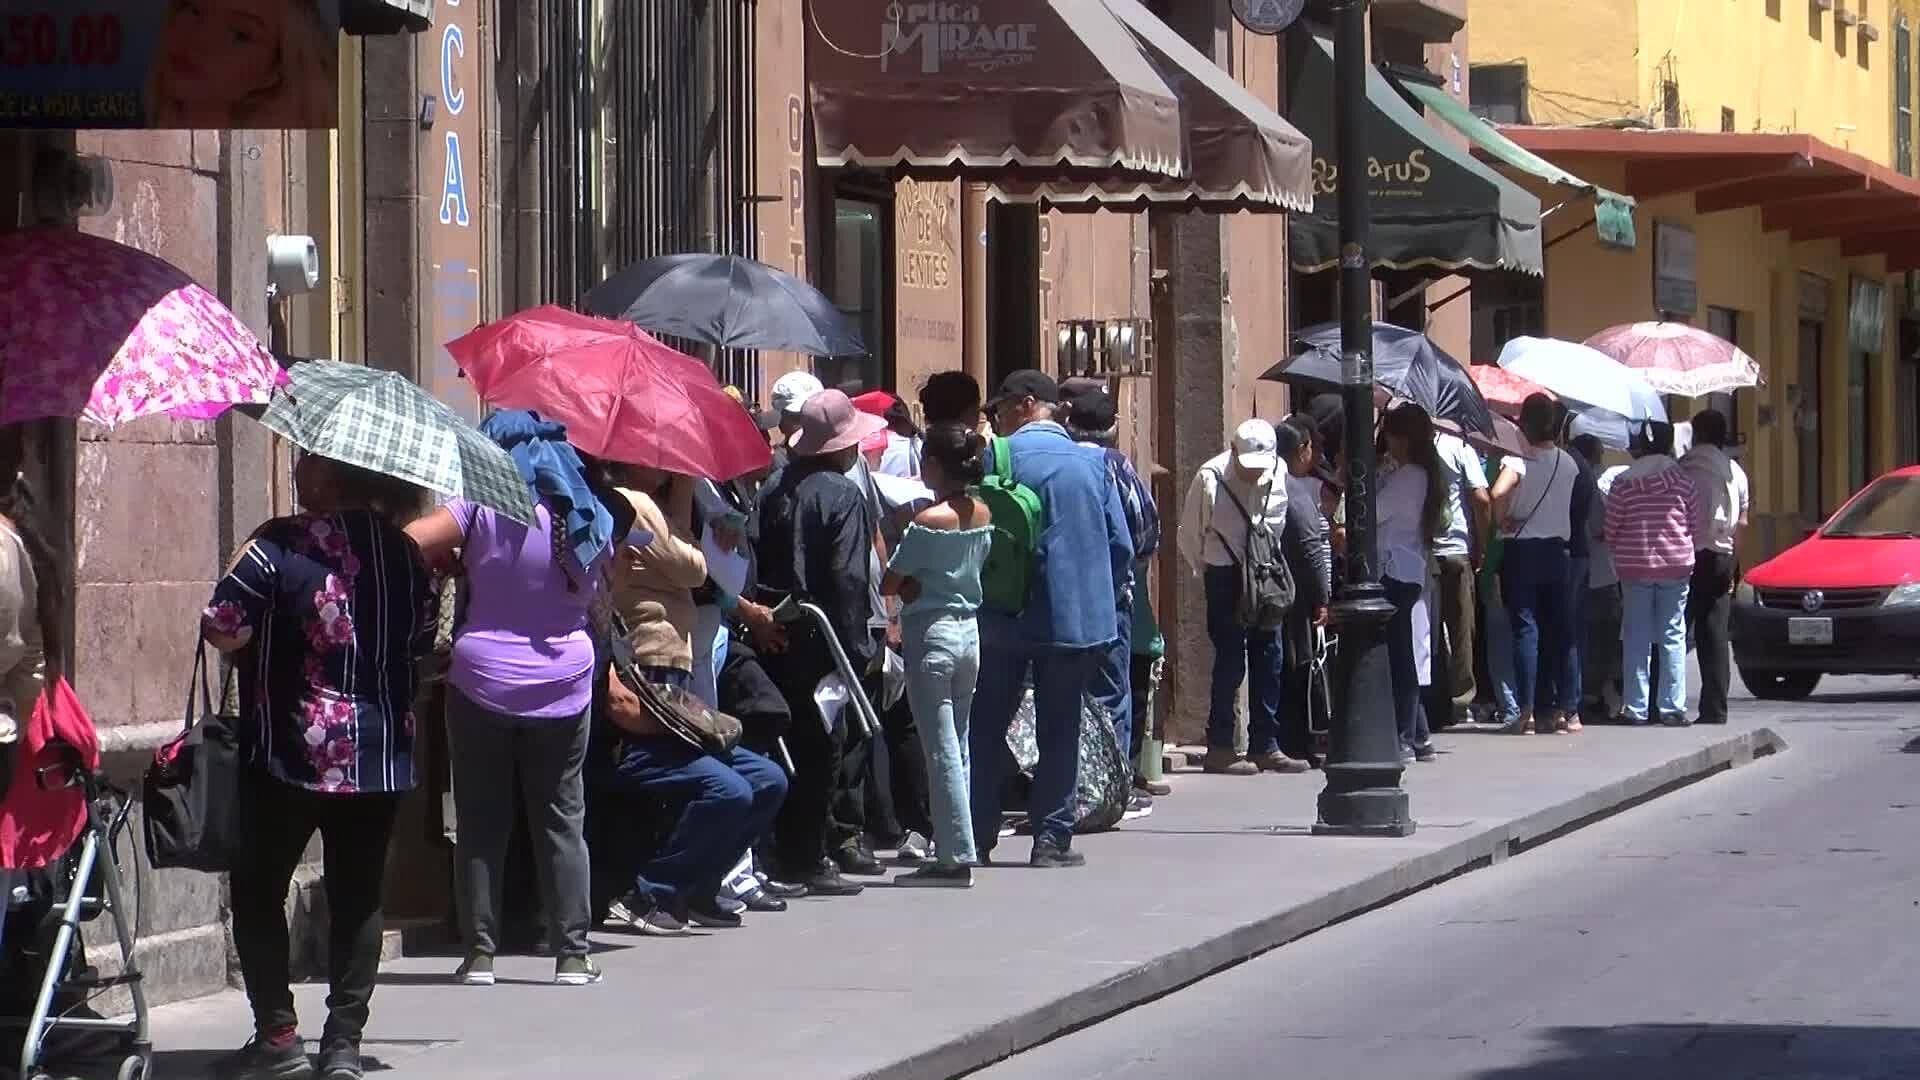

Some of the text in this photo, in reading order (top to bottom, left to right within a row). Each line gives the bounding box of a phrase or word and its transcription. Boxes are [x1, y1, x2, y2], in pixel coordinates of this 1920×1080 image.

[0, 13, 121, 64] 50.00
[881, 23, 1037, 73] MIRAGE
[440, 0, 469, 226] CA
[1366, 148, 1431, 182] aruS
[917, 209, 932, 244] DE
[902, 250, 949, 287] LENTES
